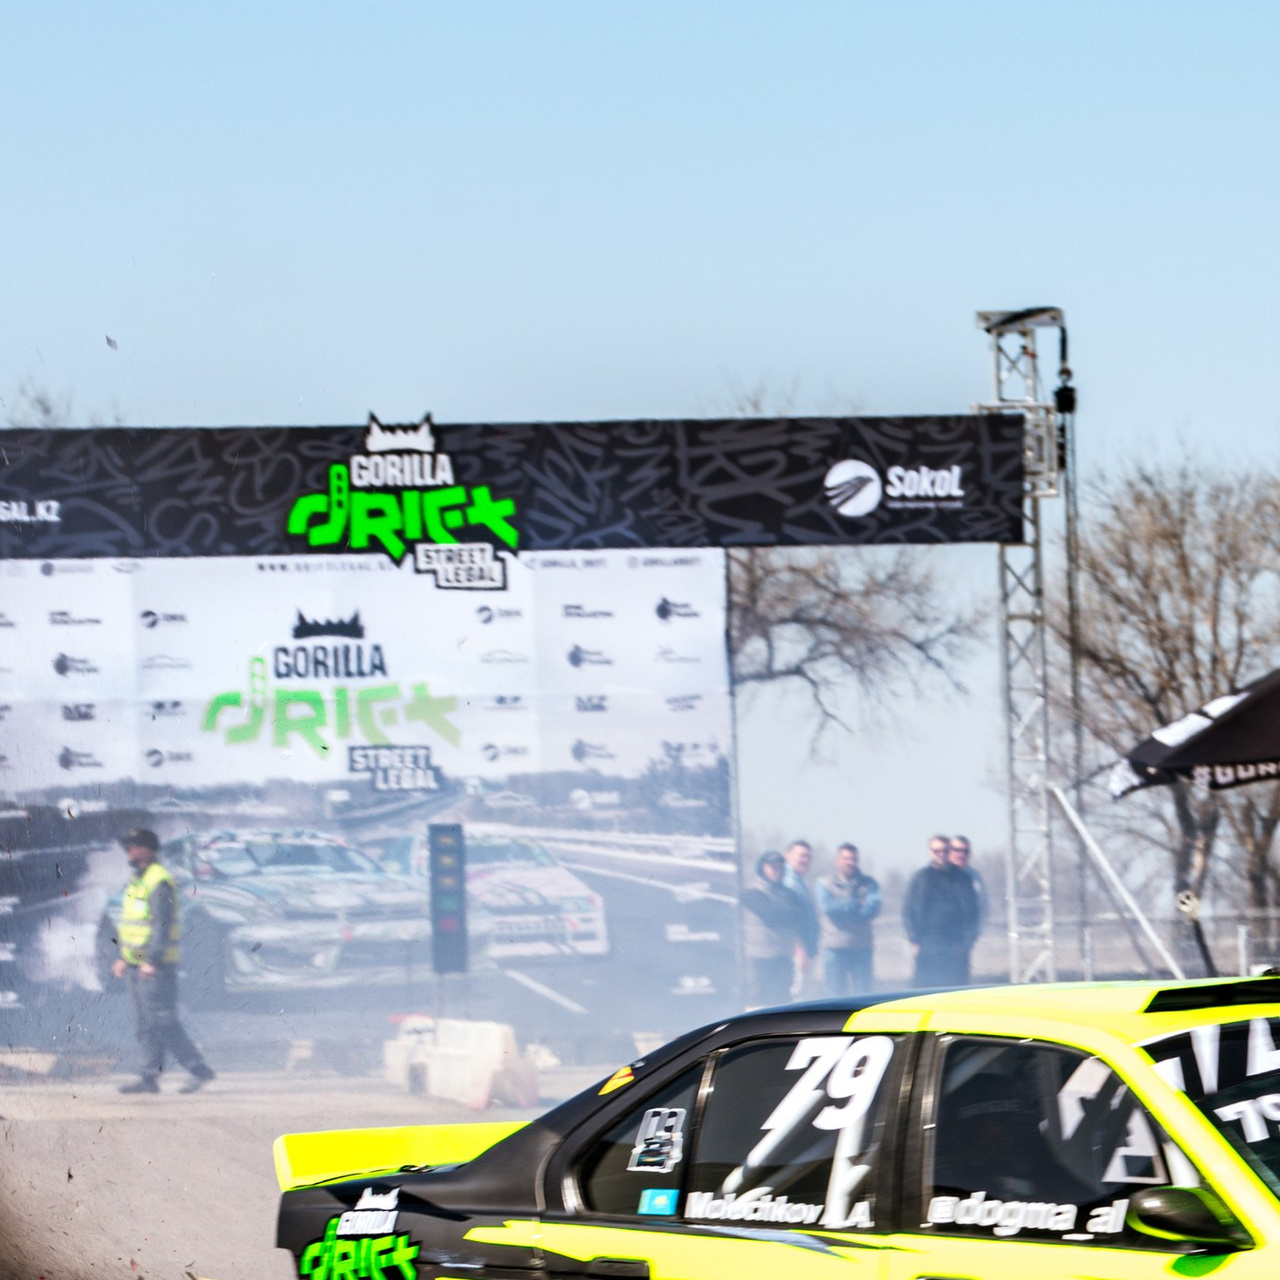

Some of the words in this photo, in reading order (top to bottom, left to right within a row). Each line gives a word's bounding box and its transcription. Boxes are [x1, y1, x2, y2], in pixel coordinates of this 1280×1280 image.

[350, 453, 454, 487] GORILLA
[423, 546, 488, 566] STREET
[442, 564, 499, 585] LEGAL
[273, 644, 389, 679] GORILLA
[350, 749, 431, 770] STREET
[374, 768, 440, 790] LEGAL
[760, 1036, 894, 1130] 79
